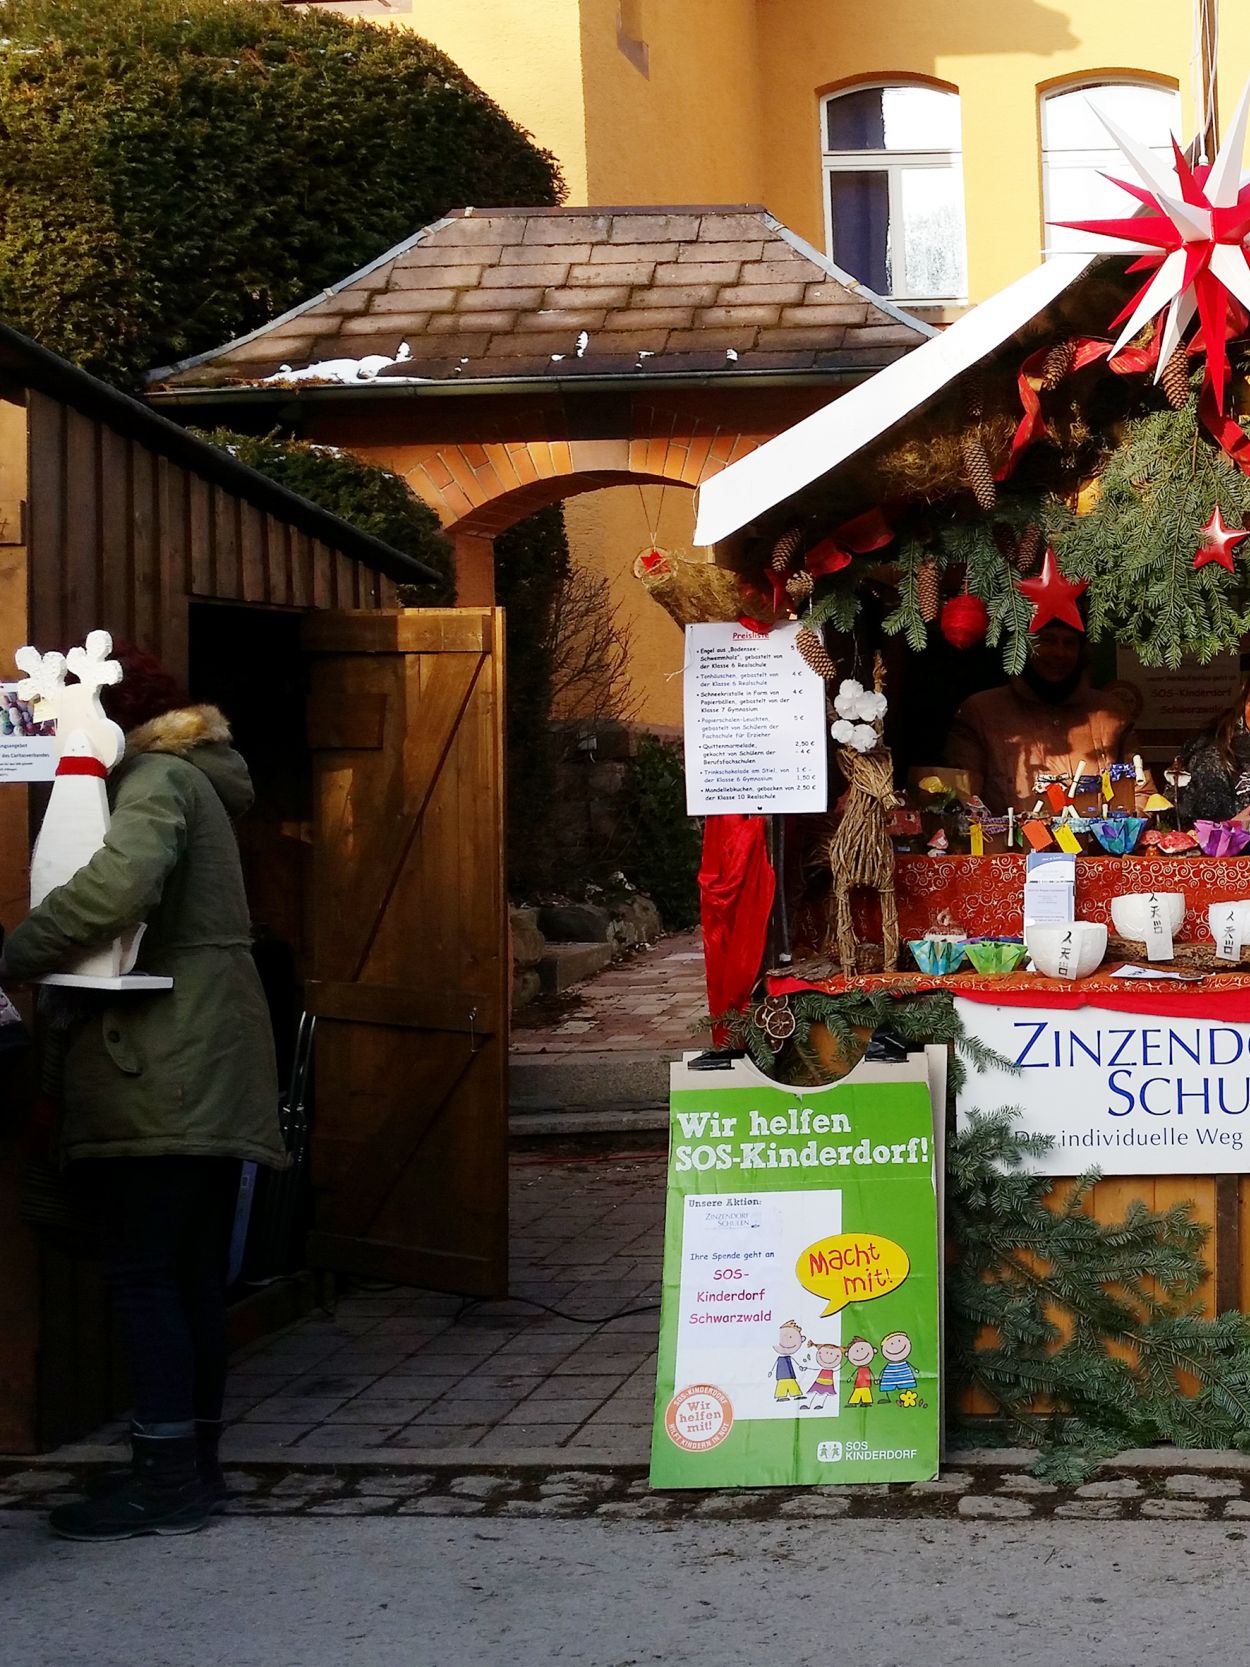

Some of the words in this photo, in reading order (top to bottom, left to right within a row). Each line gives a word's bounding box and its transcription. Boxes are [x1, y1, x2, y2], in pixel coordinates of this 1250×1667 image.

[732, 632, 769, 640] Preisliste
[676, 1112, 737, 1139] Wir
[749, 1108, 851, 1137] helfen
[1061, 1127, 1189, 1147] individuelle
[1196, 1128, 1243, 1150] Weg
[675, 1137, 929, 1172] SOS-Kinderdorf!
[689, 1200, 722, 1208] Unsere
[726, 1198, 762, 1206] Aktion:
[705, 1212, 750, 1221] ZINZENDORF
[712, 1252, 741, 1261] Spende
[744, 1251, 762, 1260] geht
[809, 1243, 881, 1277] Macht
[713, 1268, 750, 1280] SOS-
[843, 1268, 894, 1296] mit!
[696, 1289, 766, 1303] Kinderdorf
[689, 1310, 772, 1324] Schwarzwald
[688, 1401, 710, 1411] Wir
[679, 1411, 721, 1422] helfen
[687, 1421, 712, 1432] mit!
[845, 1441, 868, 1451] SOS
[845, 1449, 917, 1460] KINDERDORF
